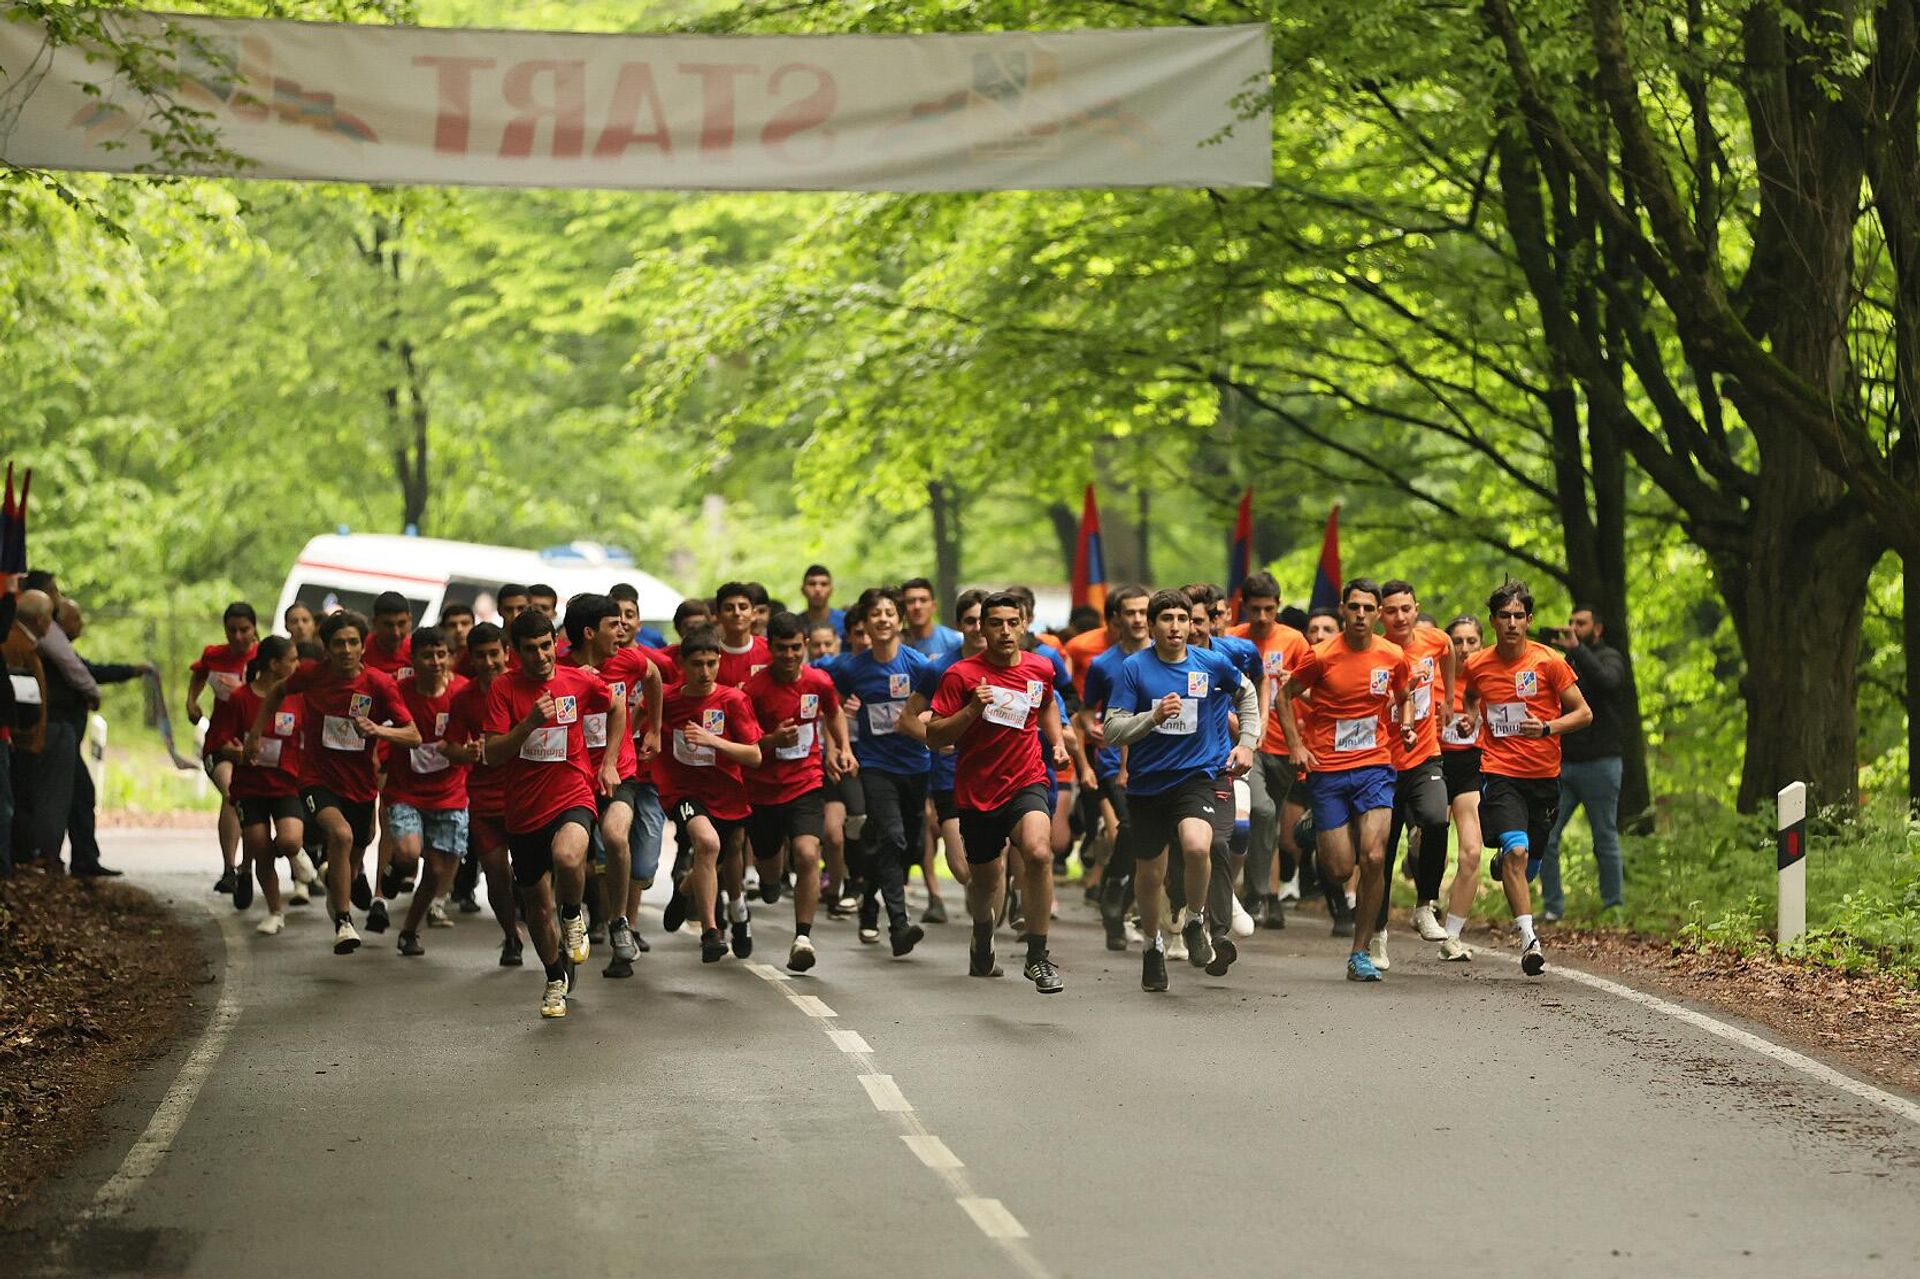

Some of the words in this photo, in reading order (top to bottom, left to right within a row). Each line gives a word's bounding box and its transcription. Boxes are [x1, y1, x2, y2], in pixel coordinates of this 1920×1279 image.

[1001, 692, 1014, 710] 2
[883, 705, 891, 718] 1
[1500, 705, 1508, 722] 1
[589, 717, 601, 734] 3
[1353, 722, 1360, 737] 1
[540, 730, 548, 747] 1
[680, 802, 695, 821] 14
